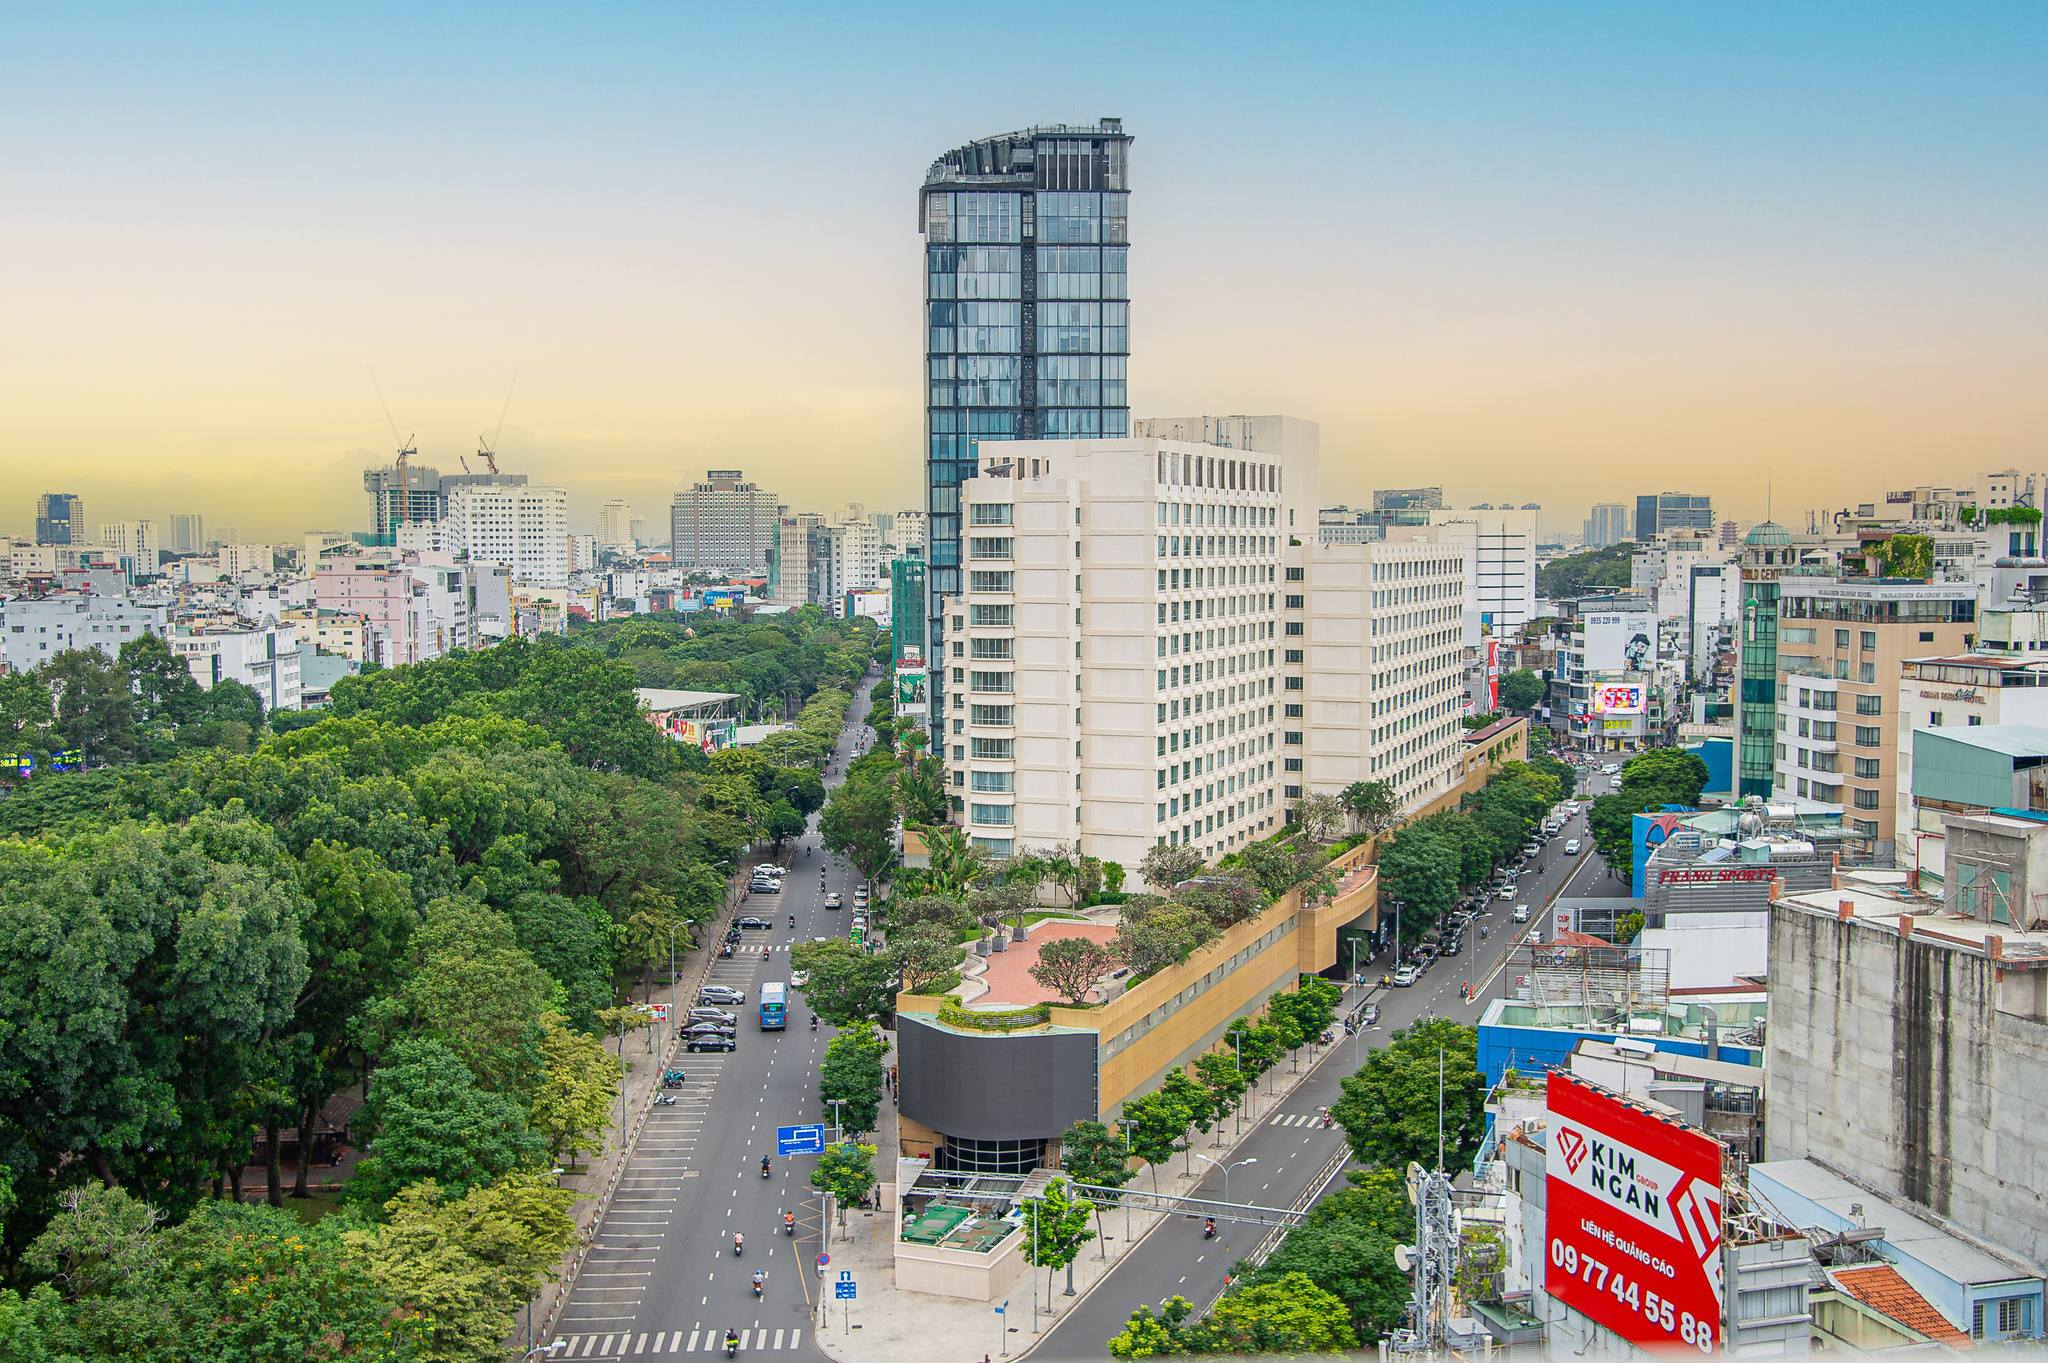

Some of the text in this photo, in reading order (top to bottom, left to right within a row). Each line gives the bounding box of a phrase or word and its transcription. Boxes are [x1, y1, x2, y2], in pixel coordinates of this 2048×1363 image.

[1590, 616, 1620, 624] 0935 220 999
[1658, 867, 1777, 885] TRANG SPORTS
[1592, 1139, 1635, 1181] KIM
[1592, 1164, 1659, 1219] NGAN
[1636, 1174, 1659, 1191] GROUP
[1581, 1218, 1675, 1279] LIÊN HỆ QUẢNG CÁO
[1551, 1238, 1713, 1354] 09 77 44 55 88
